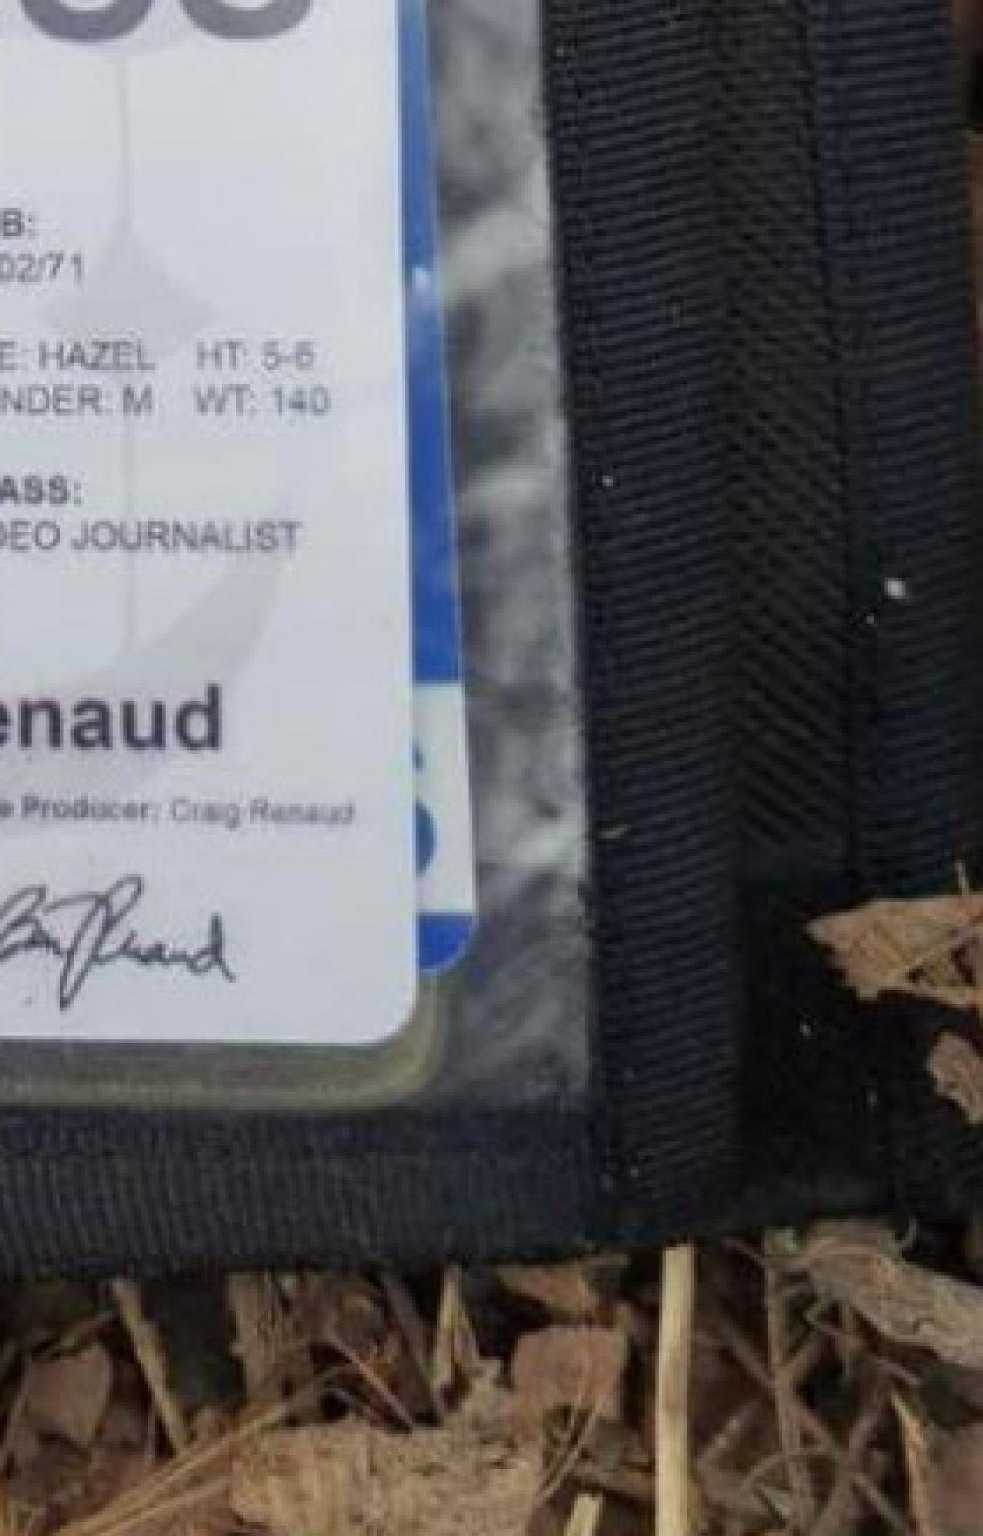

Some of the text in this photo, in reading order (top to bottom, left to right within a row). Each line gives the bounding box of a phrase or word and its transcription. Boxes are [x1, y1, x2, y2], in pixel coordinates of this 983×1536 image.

[38, 341, 155, 371] HAZEL
[196, 341, 248, 371] HT:
[123, 385, 153, 415] M
[194, 385, 258, 416] WT:
[272, 386, 331, 416] 140
[70, 520, 302, 553] JOURNALIST
[20, 792, 157, 822] Producer:
[169, 798, 240, 831] Craig
[250, 797, 356, 825] Renaud
